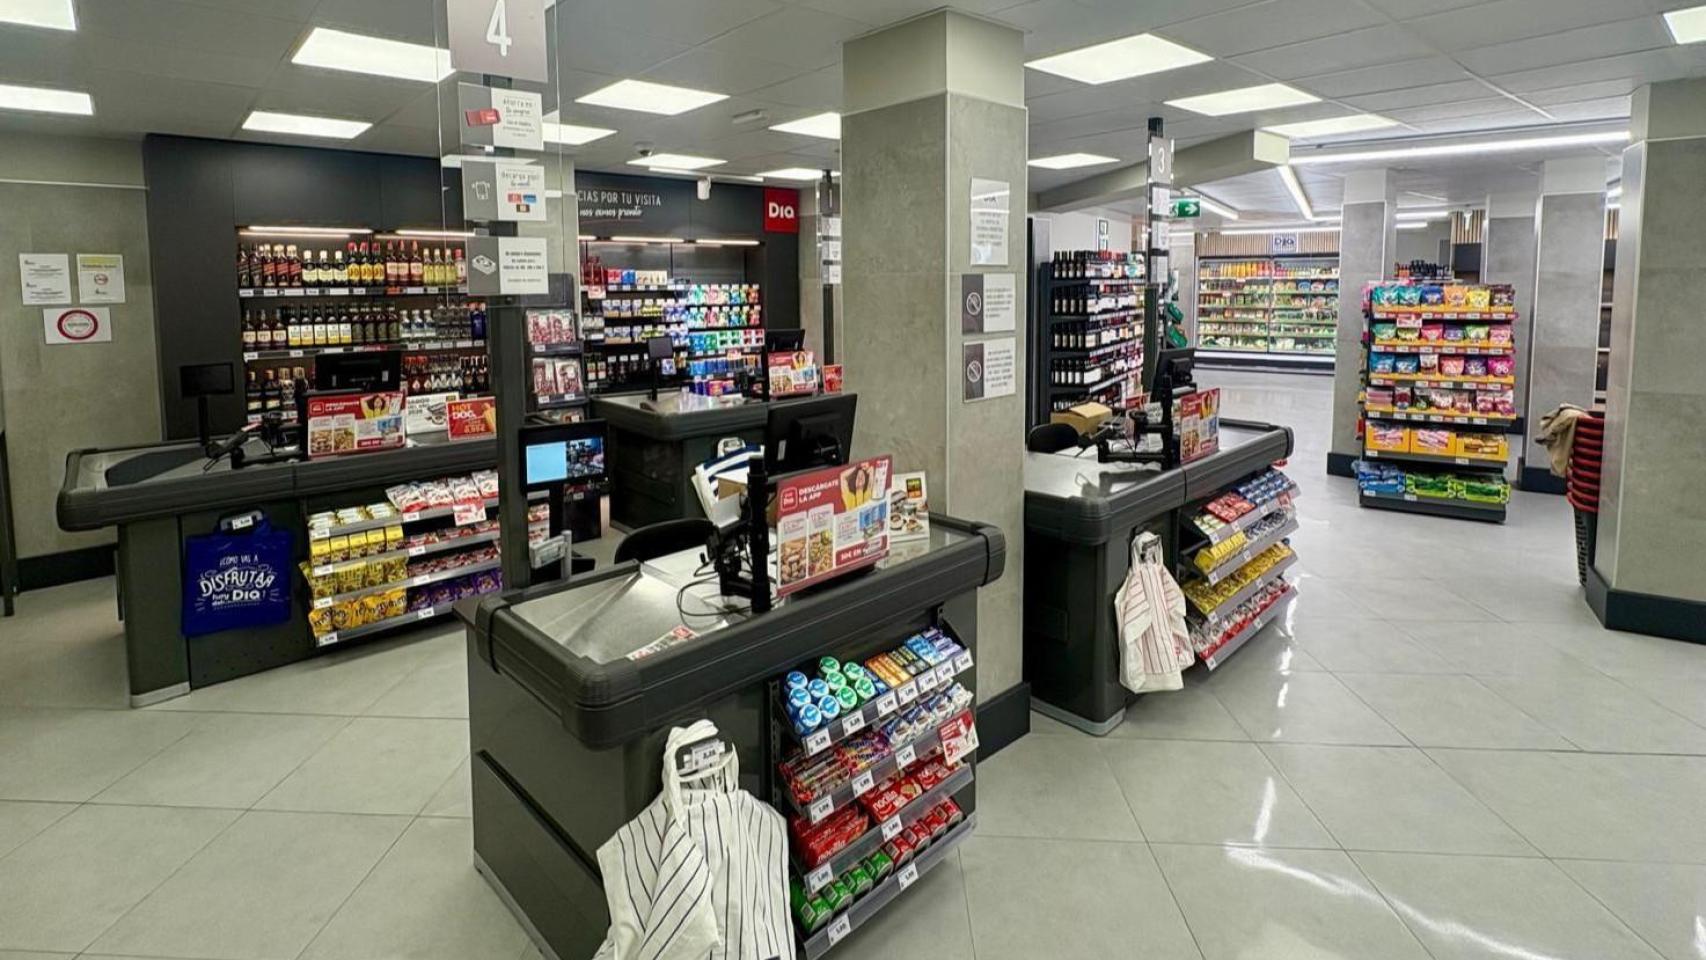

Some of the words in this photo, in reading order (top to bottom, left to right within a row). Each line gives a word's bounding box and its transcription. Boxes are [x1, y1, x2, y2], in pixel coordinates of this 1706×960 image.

[486, 0, 512, 56] 4
[1158, 147, 1165, 173] 3
[600, 191, 618, 204] POR
[621, 192, 632, 205] TU
[634, 193, 661, 207] VISITA
[452, 403, 472, 411] HOT
[799, 496, 807, 504] LA
[809, 491, 822, 501] APP
[254, 554, 259, 563] A
[200, 566, 275, 597] DISFRUTAR
